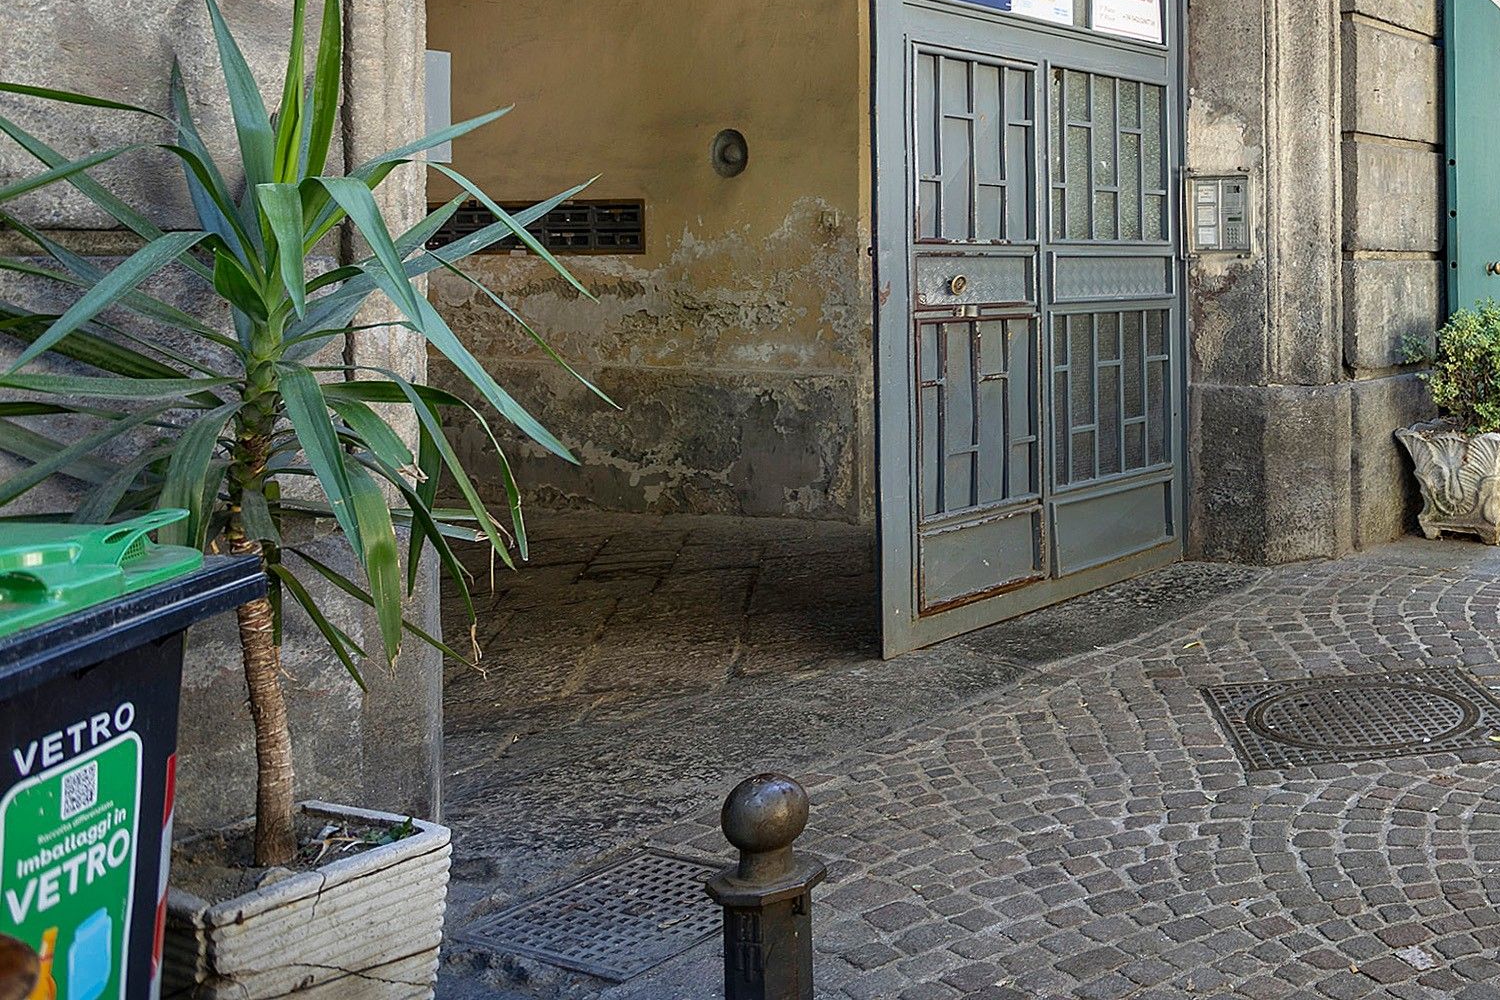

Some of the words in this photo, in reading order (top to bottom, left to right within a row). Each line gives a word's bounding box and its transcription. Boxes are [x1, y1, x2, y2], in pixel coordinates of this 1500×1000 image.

[12, 700, 136, 777] VETRO
[5, 827, 131, 926] VETRO
[16, 812, 113, 879] Imballaggi
[113, 806, 127, 828] in
